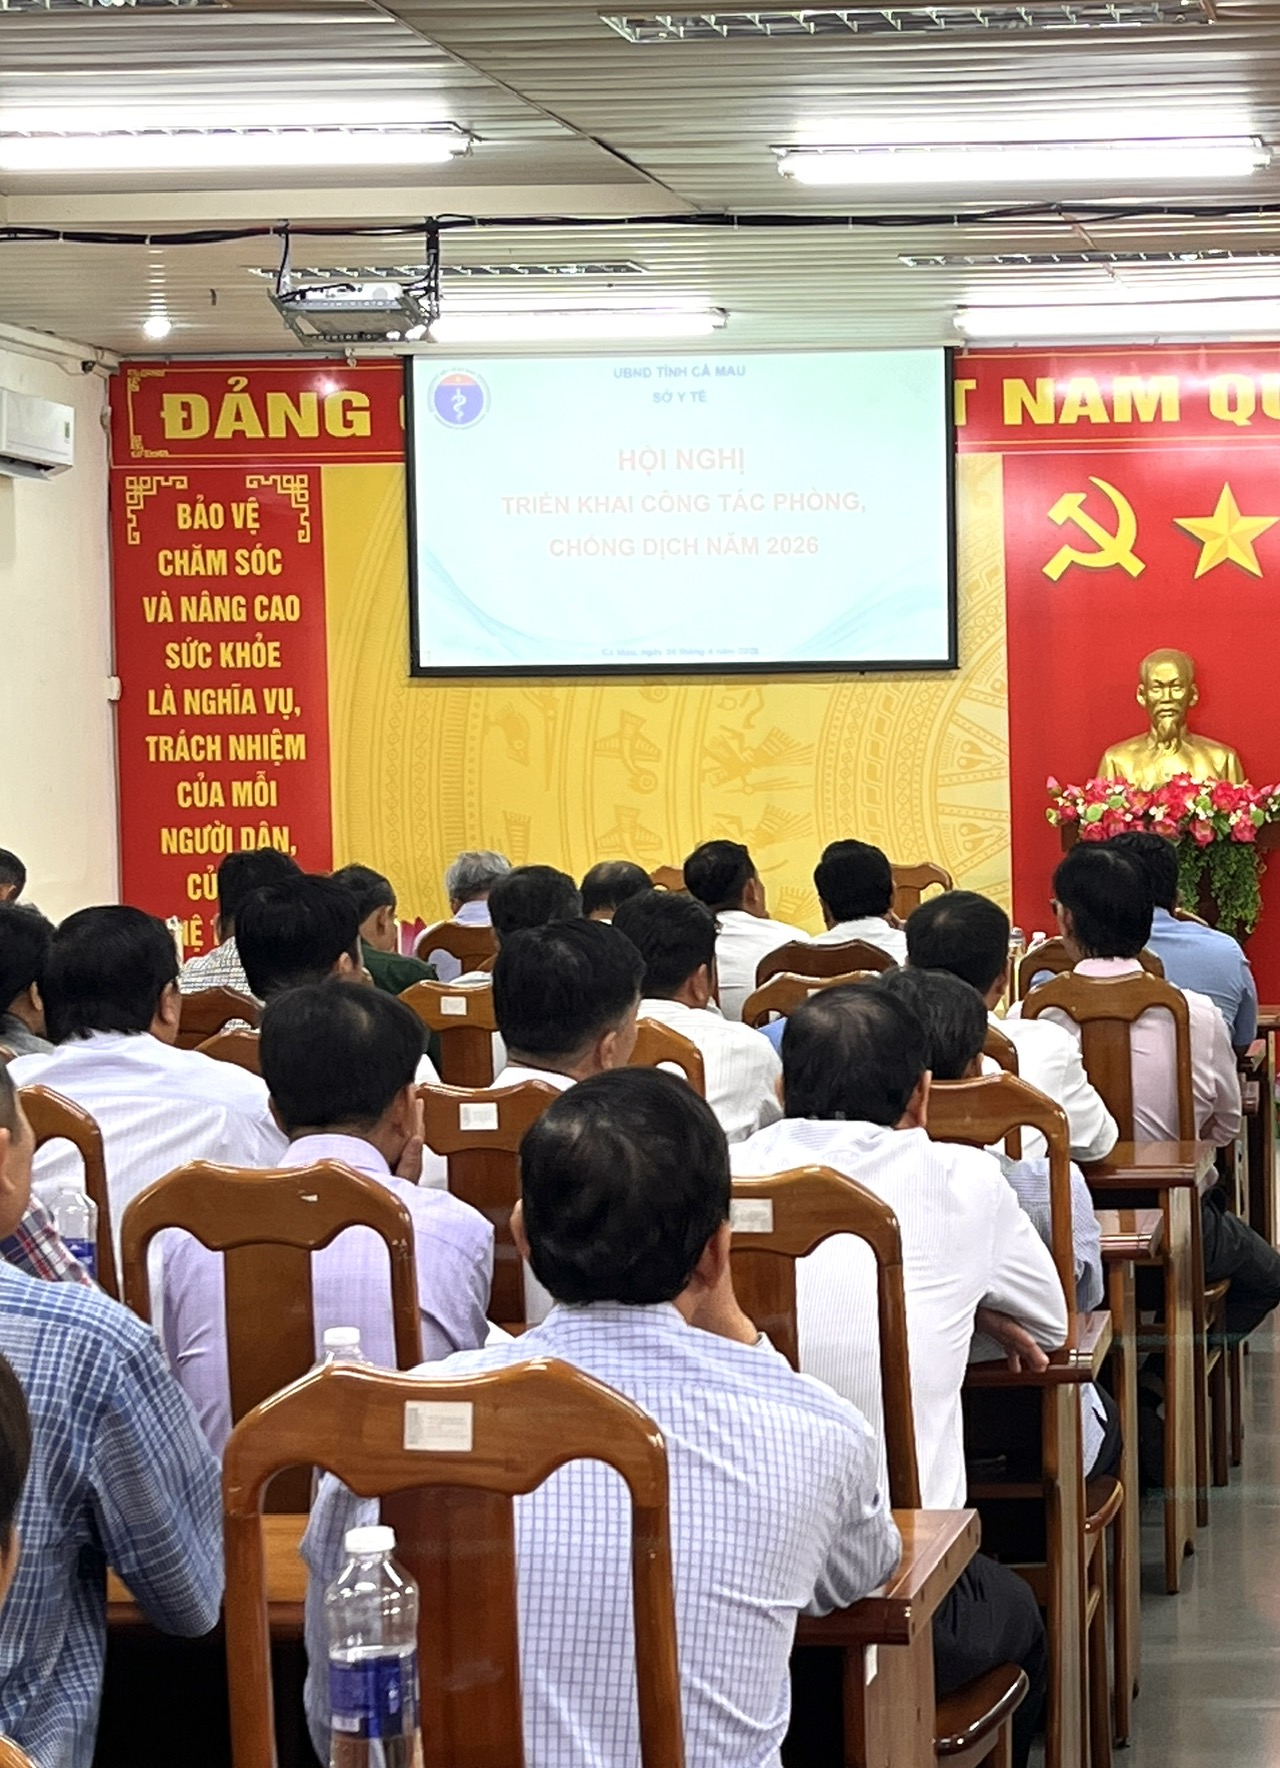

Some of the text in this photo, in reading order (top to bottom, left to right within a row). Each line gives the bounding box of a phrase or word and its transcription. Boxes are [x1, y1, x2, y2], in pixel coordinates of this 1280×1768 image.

[613, 366, 652, 380] UBND
[715, 364, 747, 377] MAU
[160, 376, 371, 440] ĐẢNG
[1003, 375, 1181, 426] NAM
[652, 390, 674, 404] SỞ
[677, 391, 687, 403] Y
[618, 445, 745, 476] HỘI NGHỊ
[177, 494, 261, 536] BẢO VỆ
[501, 487, 867, 515] TRIỂN KHAI CÔNG TÁC PHÒNG,
[158, 544, 282, 576] CHĂM SÓC
[549, 532, 819, 560] CHỐNG DỊCH NĂM 2026
[143, 591, 301, 623] VÀ NÂNG CAO
[165, 632, 282, 669] SỨC KHỎE
[148, 683, 302, 721] LÀ NGHĨA VỤ,
[145, 728, 306, 767] TRÁCH NHIỆM
[177, 770, 277, 807] CỦA MỖI
[161, 820, 297, 856] NGƯỜI DÂN,
[187, 864, 218, 900] CỦ
